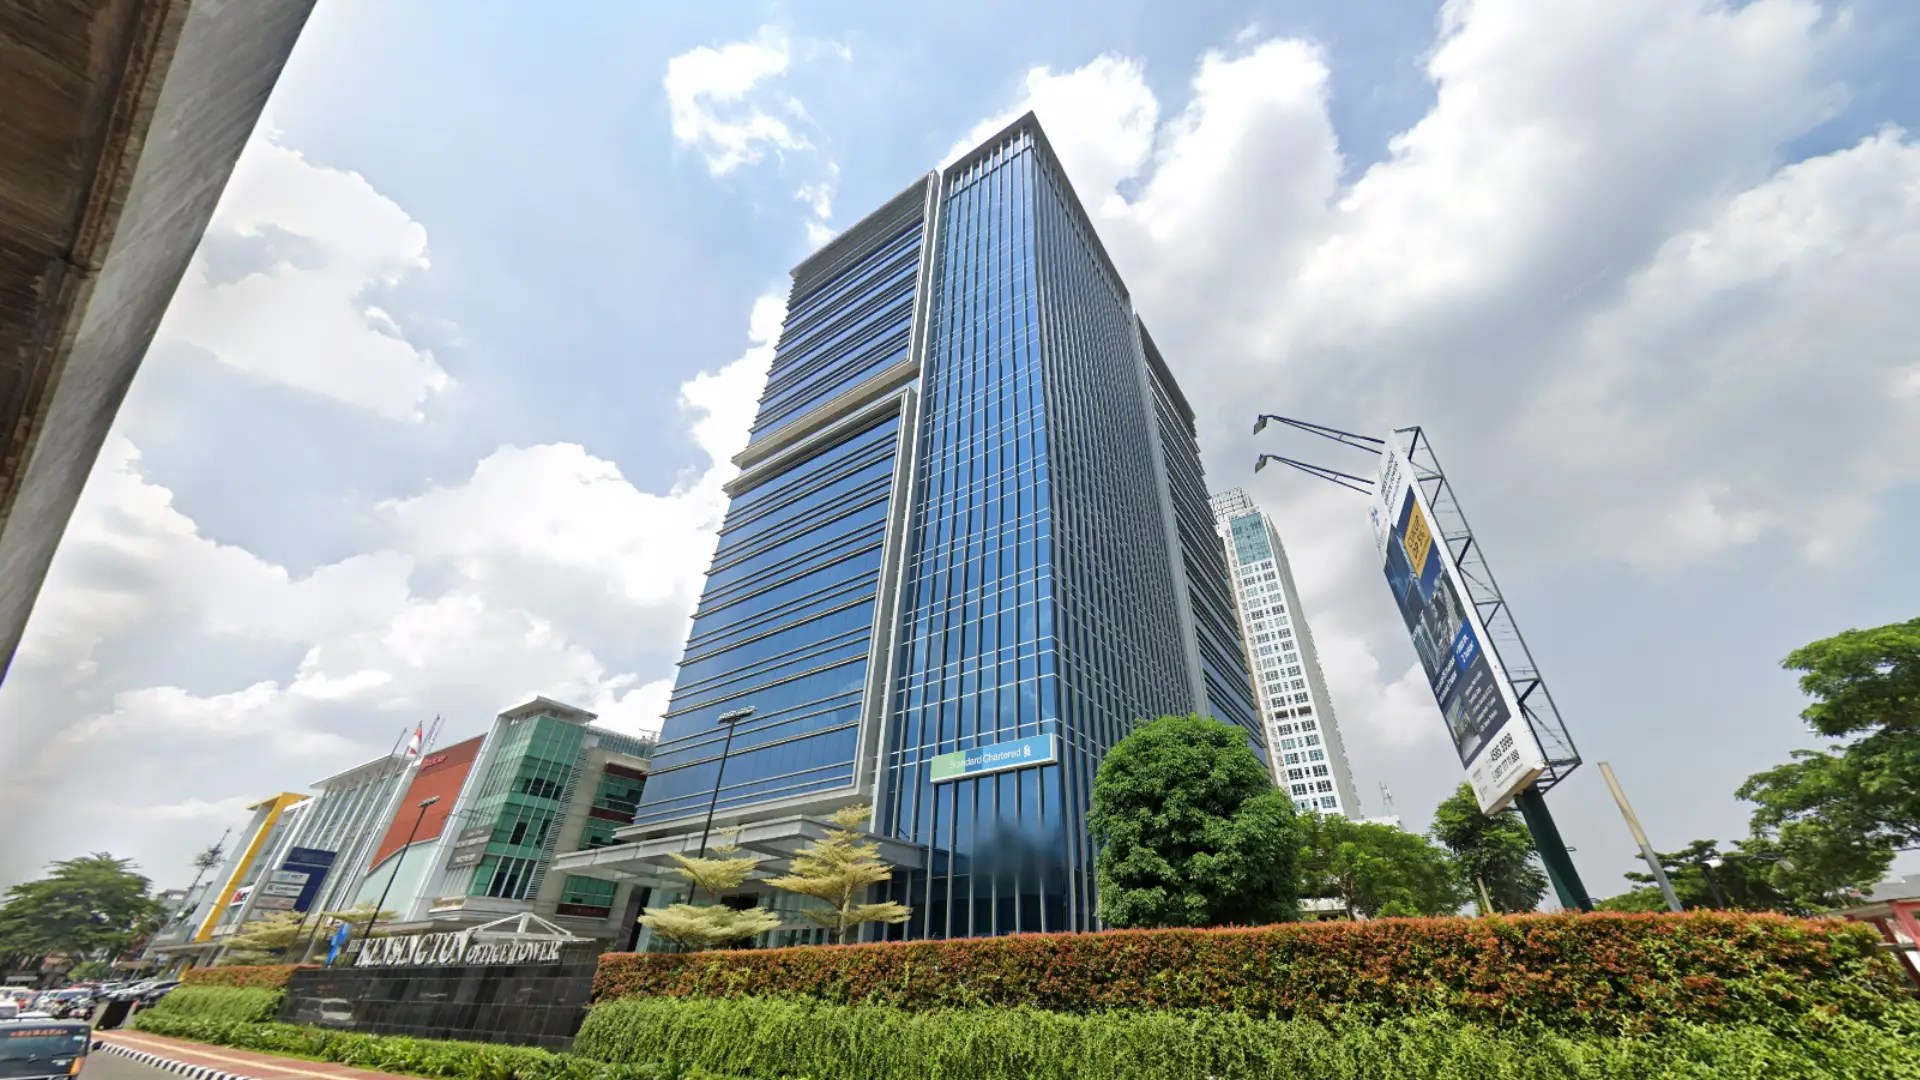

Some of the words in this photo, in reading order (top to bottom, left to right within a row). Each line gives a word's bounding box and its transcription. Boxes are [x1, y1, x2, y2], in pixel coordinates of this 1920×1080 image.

[950, 755, 983, 769] Standard
[983, 748, 1020, 763] Chartered
[354, 931, 470, 967] KENSINGTON
[465, 943, 510, 965] OFFICE
[507, 941, 563, 965] TOWER
